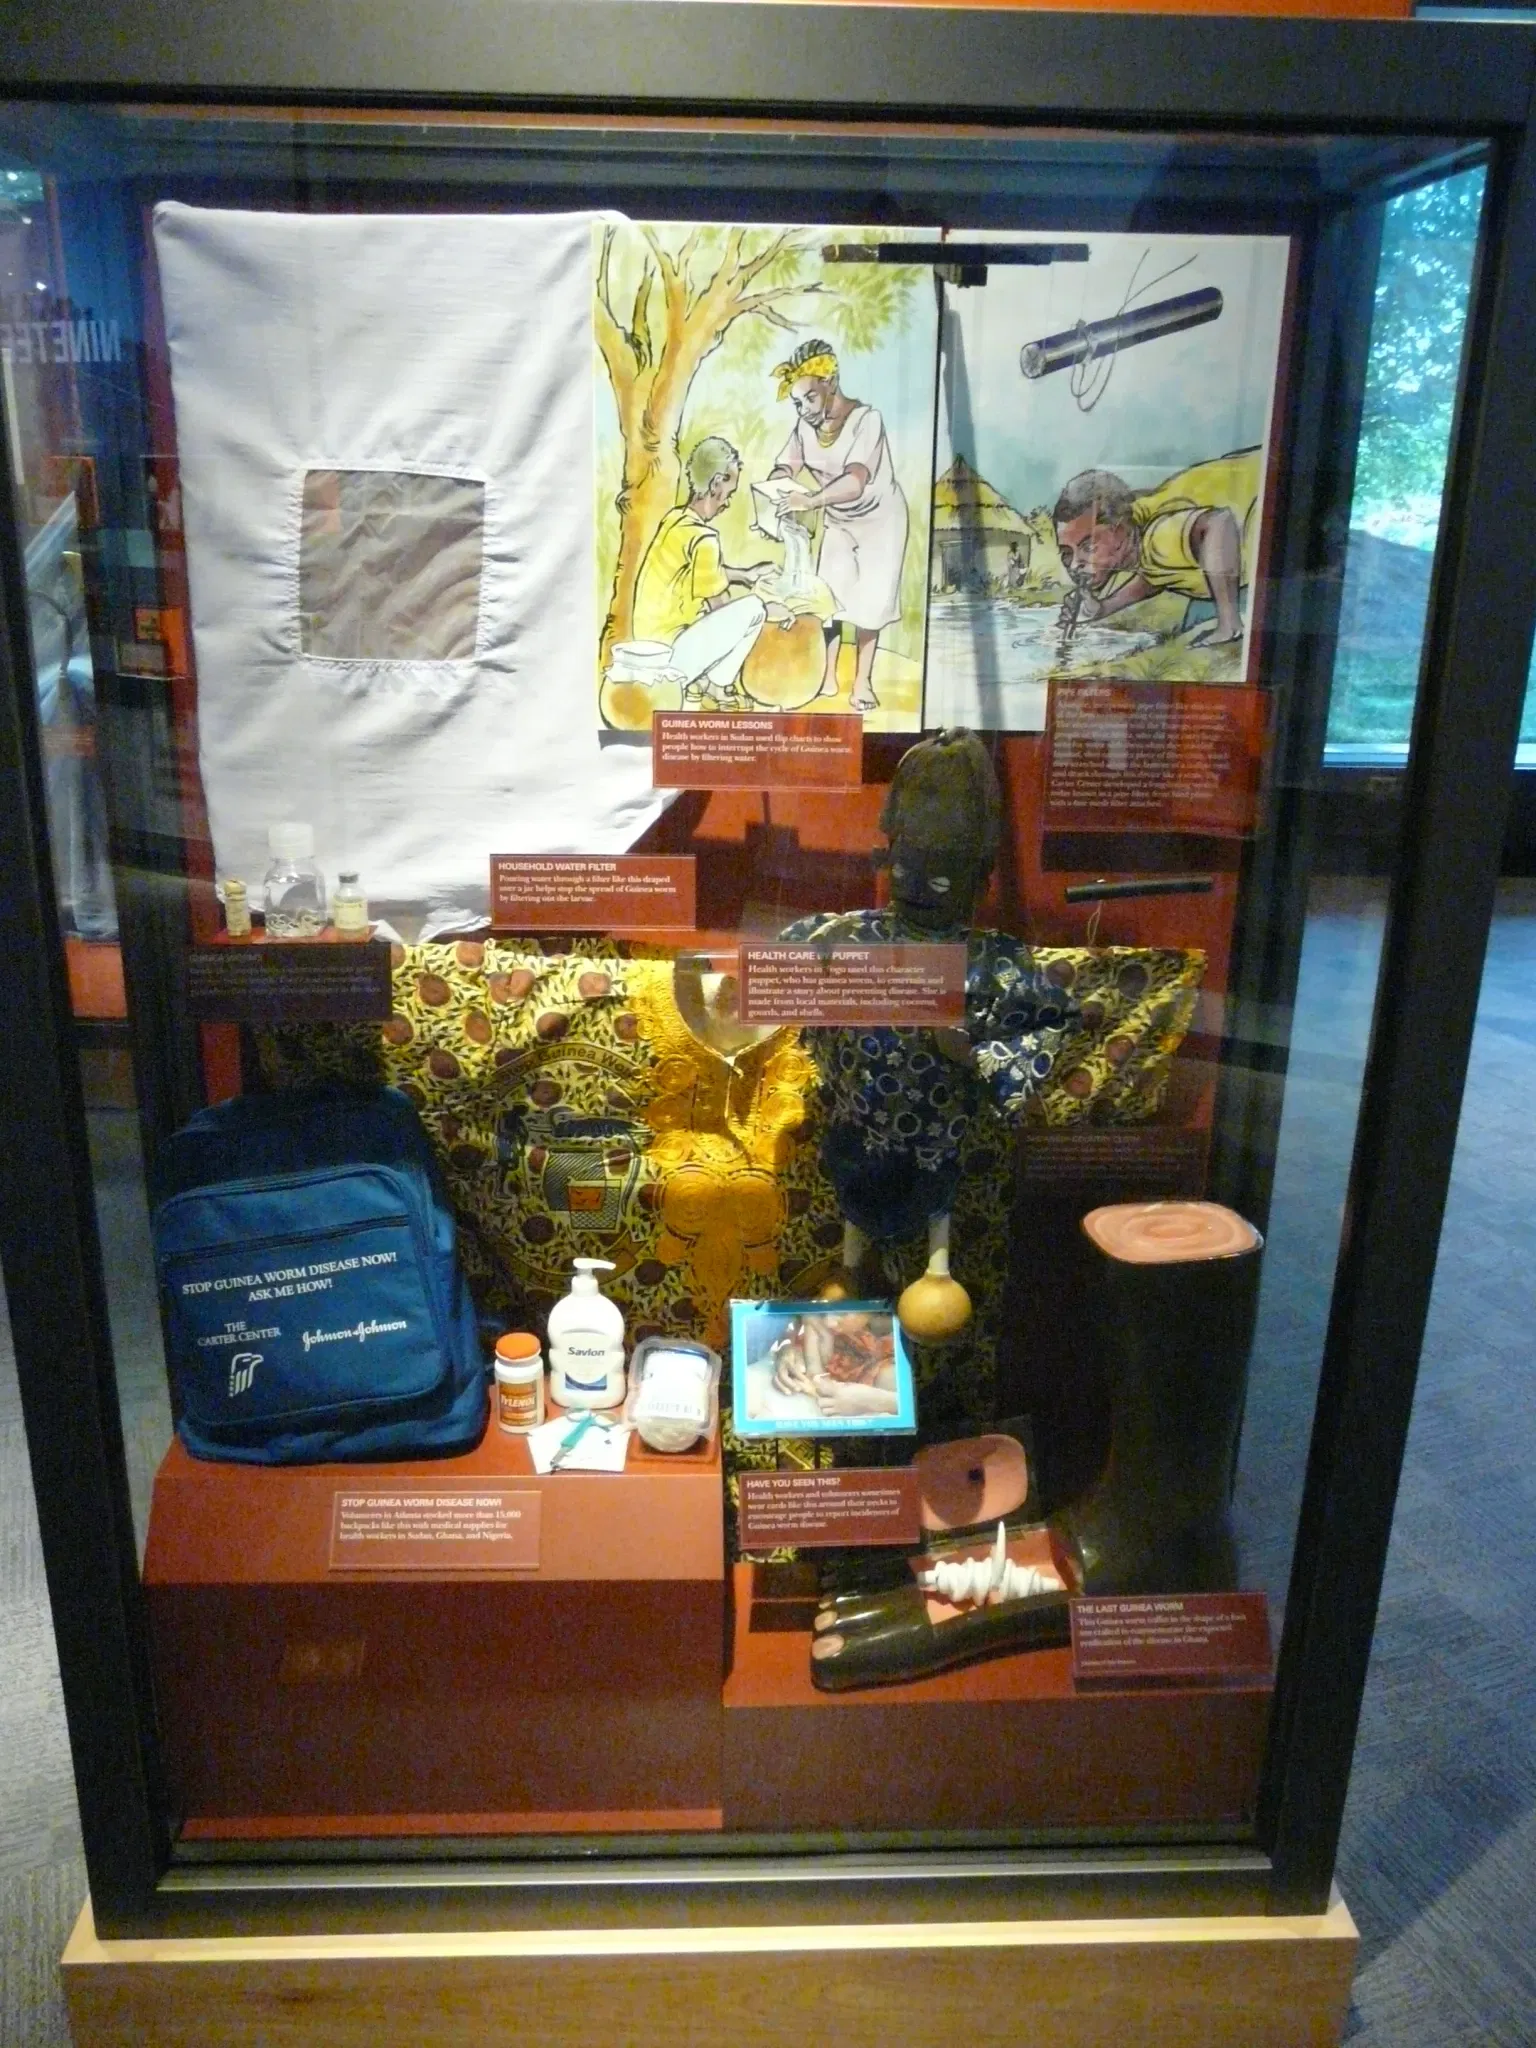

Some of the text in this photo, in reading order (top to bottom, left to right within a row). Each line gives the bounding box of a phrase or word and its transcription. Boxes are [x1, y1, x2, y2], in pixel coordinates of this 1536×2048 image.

[662, 720, 773, 730] GUINEA WORM LESSONS
[662, 732, 688, 740] Health
[690, 732, 719, 741] workers
[721, 732, 728, 741] in
[730, 733, 754, 742] Sudan
[756, 733, 774, 742] used
[662, 742, 688, 753] people
[690, 743, 706, 751] how
[718, 744, 754, 754] interrupt
[756, 744, 768, 752] the
[770, 744, 788, 754] cycle
[662, 752, 690, 761] disease
[690, 753, 700, 763] by
[702, 754, 733, 764] filtering
[498, 862, 616, 872] HOUSEHOLD WATER FILTER
[500, 874, 530, 884] Pouring
[554, 875, 584, 884] through
[642, 876, 670, 885] draped
[536, 884, 556, 894] helps
[588, 885, 614, 895] spread
[500, 894, 508, 904] by
[510, 894, 541, 904] filtering
[748, 952, 787, 960] HEALTH
[788, 952, 816, 960] CARE
[832, 952, 870, 960] PUPPET
[748, 964, 778, 974] Health
[780, 965, 812, 974] workers
[848, 964, 868, 974] used
[868, 964, 885, 974] this
[886, 965, 926, 974] character
[748, 976, 782, 987] puppet,
[783, 976, 801, 984] who
[802, 976, 817, 984] has
[748, 986, 784, 995] illustrate
[816, 986, 841, 995] about
[842, 988, 888, 997] preventing
[748, 998, 772, 1006] made
[774, 998, 795, 1006] from
[796, 998, 816, 1006] local
[782, 1008, 798, 1016] and
[539, 1045, 596, 1060] Guinea
[182, 1252, 398, 1294] STOP GUINEA WORM DISEASE NOW!
[248, 1278, 333, 1302] ASK ME HOW!
[224, 1321, 247, 1333] THE
[197, 1327, 282, 1347] CARTER CENTER
[568, 1346, 605, 1357] Savlon
[746, 1478, 840, 1488] HAVE YOU SEEN THIS?
[748, 1492, 774, 1500] Health
[774, 1490, 804, 1499] workers
[806, 1490, 820, 1498] and
[860, 1488, 900, 1496] sometimes
[341, 1498, 502, 1508] STOP GUINEA WORM DISEASE NOW!
[803, 1500, 818, 1508] this
[818, 1500, 846, 1508] around
[847, 1499, 865, 1507] their
[341, 1511, 382, 1519] Volunteers
[384, 1511, 392, 1519] in
[395, 1511, 422, 1519] Atlanta
[476, 1510, 494, 1519] than
[788, 1510, 814, 1520] people
[826, 1510, 850, 1520] report
[891, 1508, 900, 1516] of
[340, 1521, 508, 1532] backpacks like this with medical supplies for
[748, 1522, 776, 1530] Guinea
[340, 1532, 364, 1540] health
[366, 1532, 397, 1540] workers
[398, 1532, 406, 1540] in
[408, 1532, 434, 1540] Sudan,
[436, 1532, 465, 1540] Ghana,
[466, 1532, 480, 1540] and
[1076, 1604, 1094, 1614] THE
[1095, 1604, 1118, 1613] LAST
[1119, 1603, 1153, 1612] GUINEA
